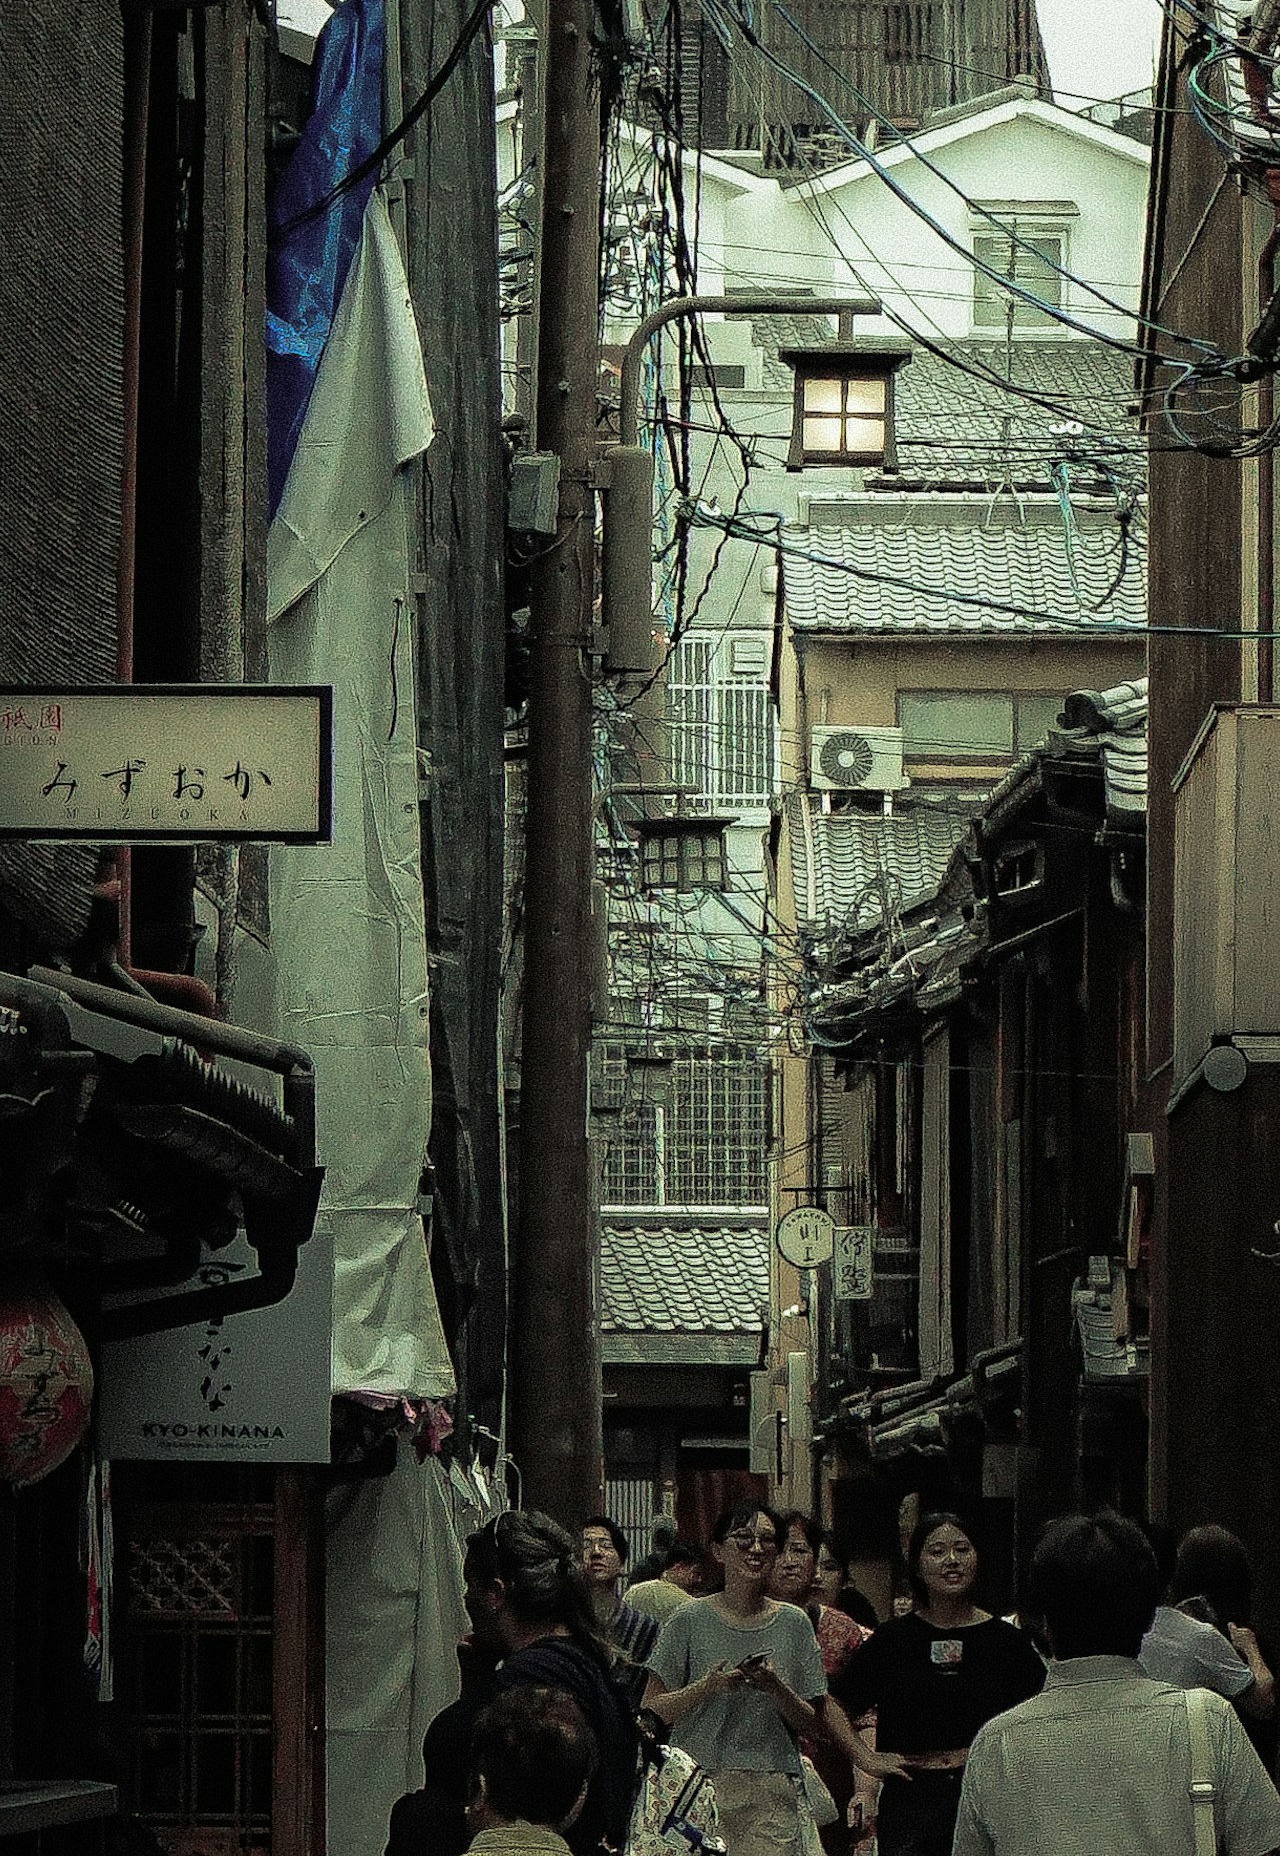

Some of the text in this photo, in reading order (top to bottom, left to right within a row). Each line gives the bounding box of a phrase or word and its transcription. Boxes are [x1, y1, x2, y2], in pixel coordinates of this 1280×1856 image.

[38, 758, 272, 804] みずおか
[65, 807, 249, 822] MIZUOKA
[142, 1423, 286, 1440] KYO-KINANA
